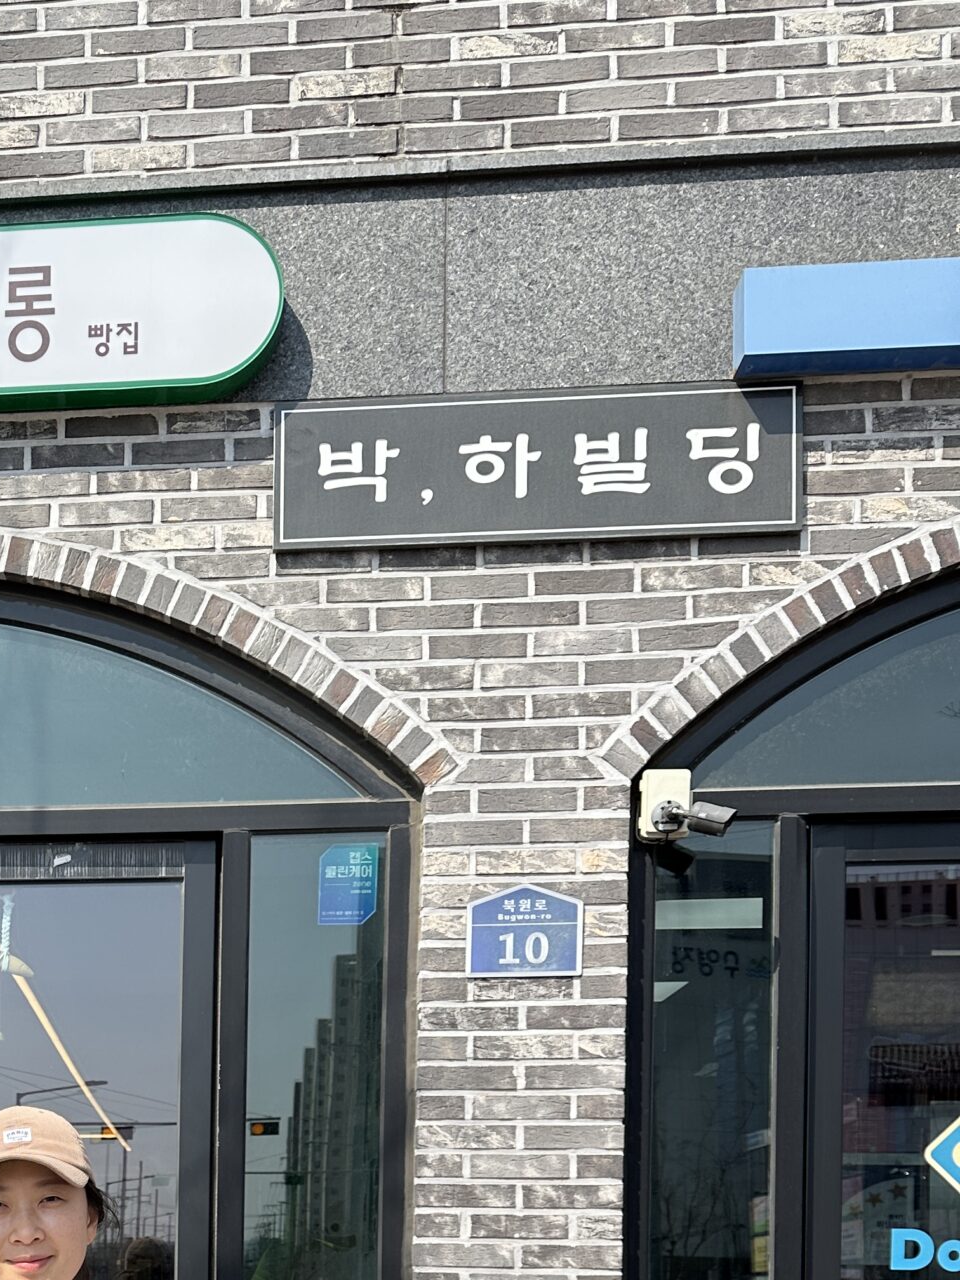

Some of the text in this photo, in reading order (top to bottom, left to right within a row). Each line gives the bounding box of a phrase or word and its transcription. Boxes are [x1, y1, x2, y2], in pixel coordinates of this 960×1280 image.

[86, 321, 141, 357] 빵집
[316, 422, 761, 506] 박, 하빌딩
[349, 851, 372, 864] 캡스
[325, 865, 372, 878] 클린케어
[502, 898, 548, 912] 북원로
[497, 913, 552, 922] Bugwon-ro
[498, 931, 549, 965] 10
